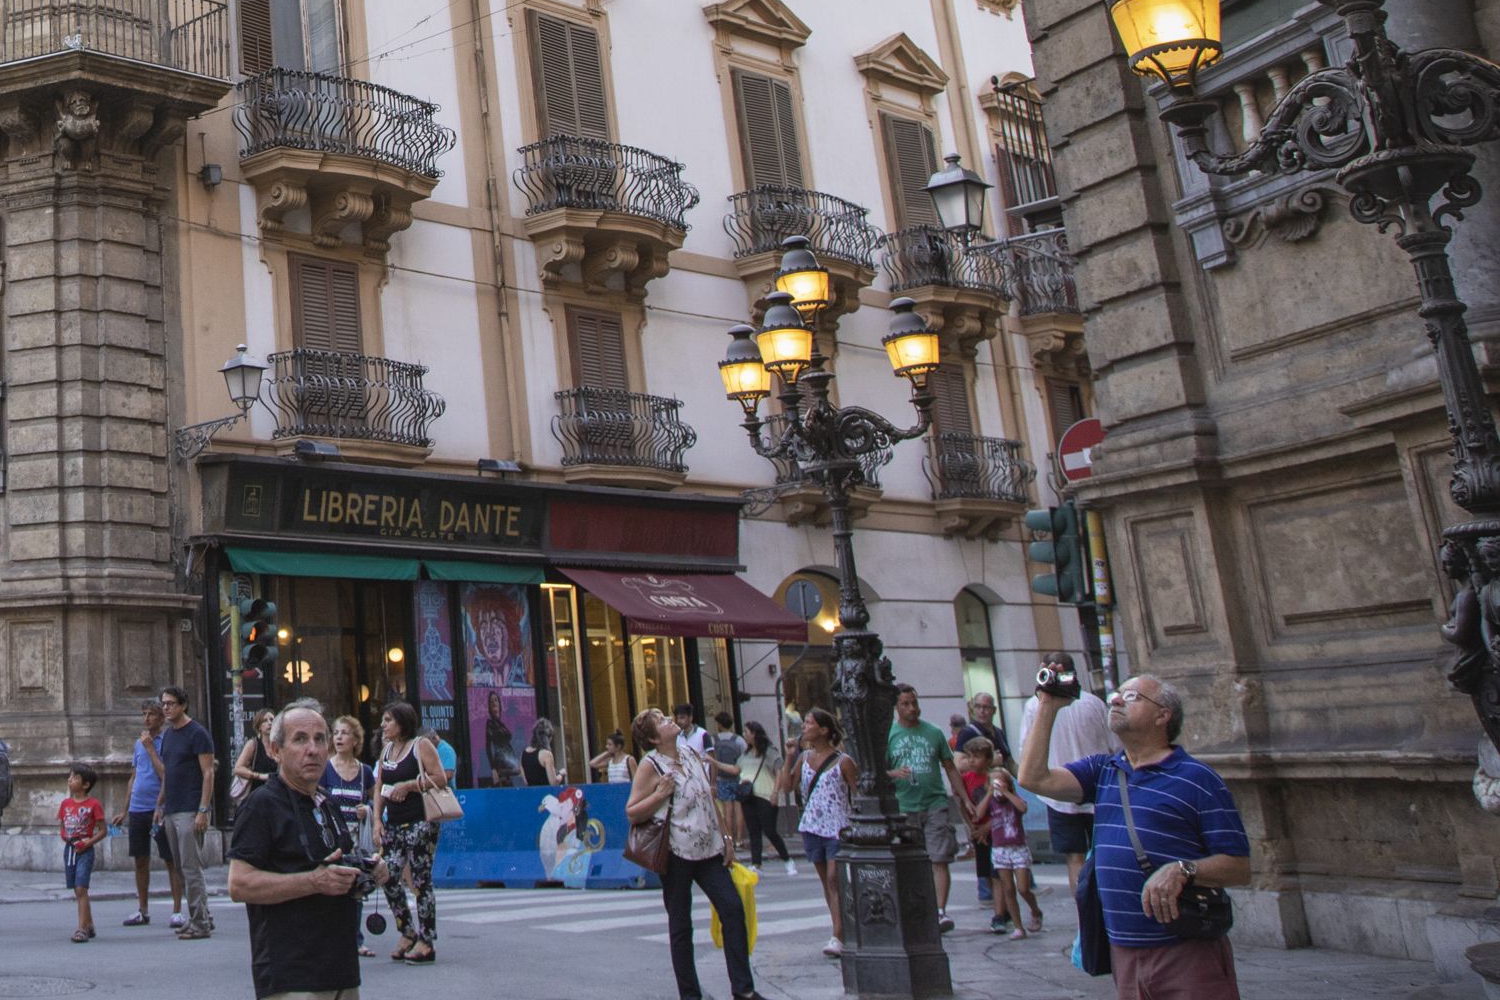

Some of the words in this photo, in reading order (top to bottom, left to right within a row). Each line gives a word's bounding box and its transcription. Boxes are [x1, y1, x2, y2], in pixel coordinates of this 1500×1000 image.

[302, 488, 424, 530] LIBRERIA
[439, 499, 522, 537] DANTE
[649, 594, 709, 609] COSTA
[707, 622, 736, 636] COSTA
[421, 705, 428, 718] IL
[429, 704, 454, 718] QUINTO
